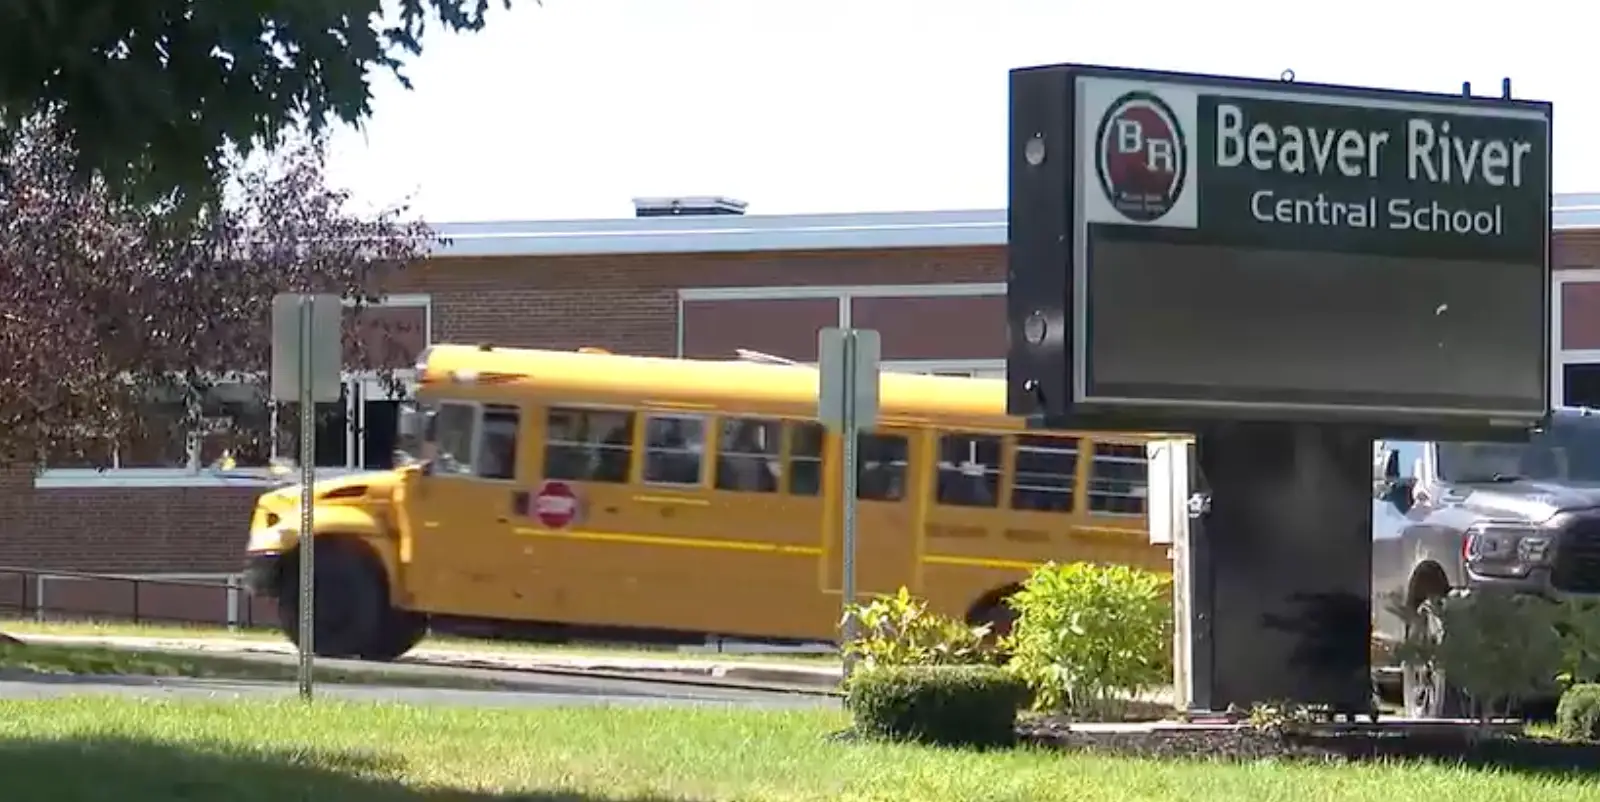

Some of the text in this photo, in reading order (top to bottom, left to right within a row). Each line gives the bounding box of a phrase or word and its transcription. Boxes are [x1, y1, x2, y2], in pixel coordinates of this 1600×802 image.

[1217, 105, 1531, 187] Beaver River
[1251, 190, 1503, 235] Central School
